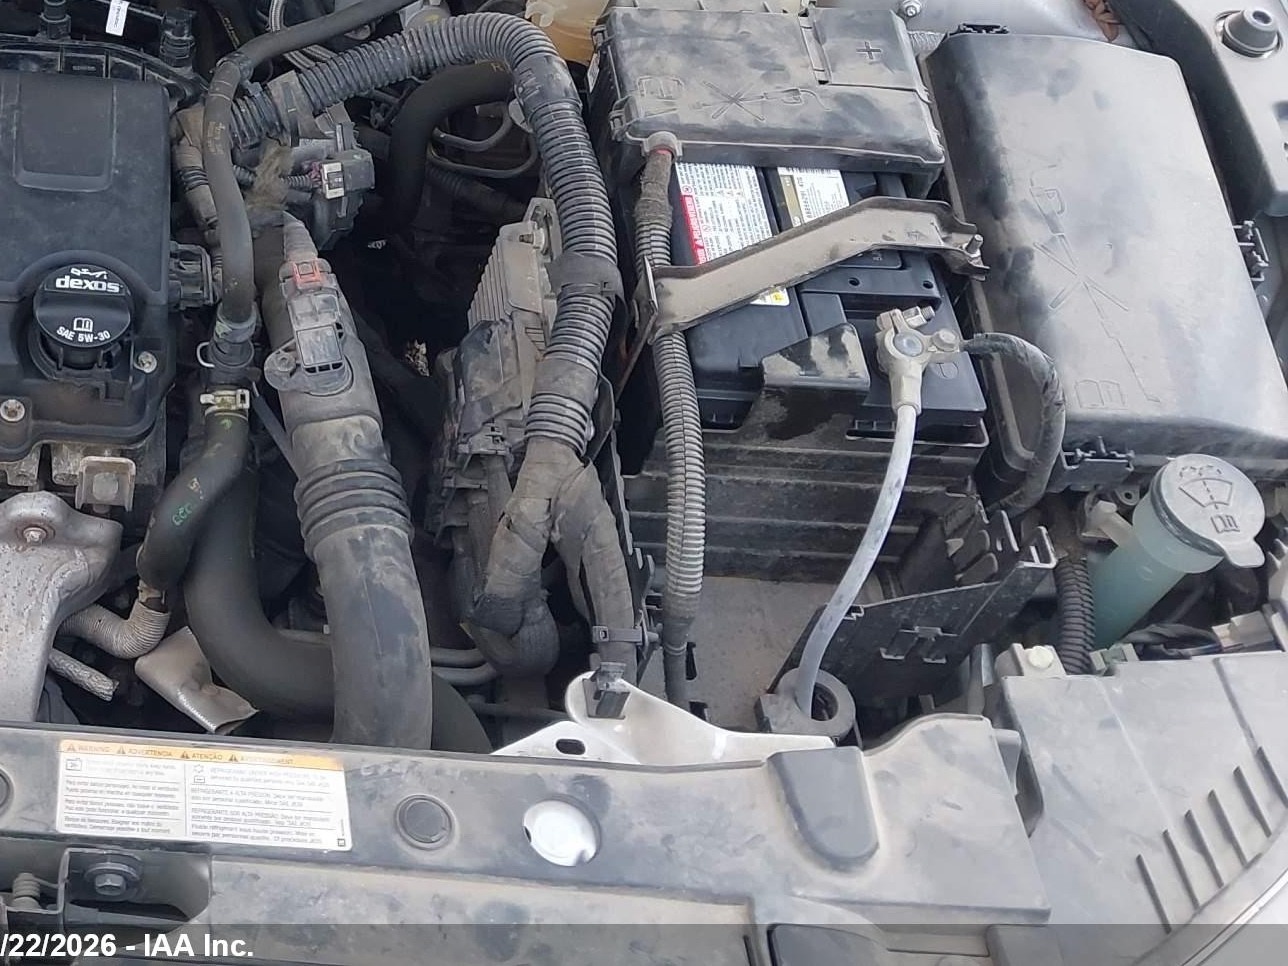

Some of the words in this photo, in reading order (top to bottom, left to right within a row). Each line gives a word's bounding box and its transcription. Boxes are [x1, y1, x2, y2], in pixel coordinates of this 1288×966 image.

[55, 275, 120, 293] dexos
[56, 326, 75, 341] SAE
[78, 330, 111, 343] 5W-30
